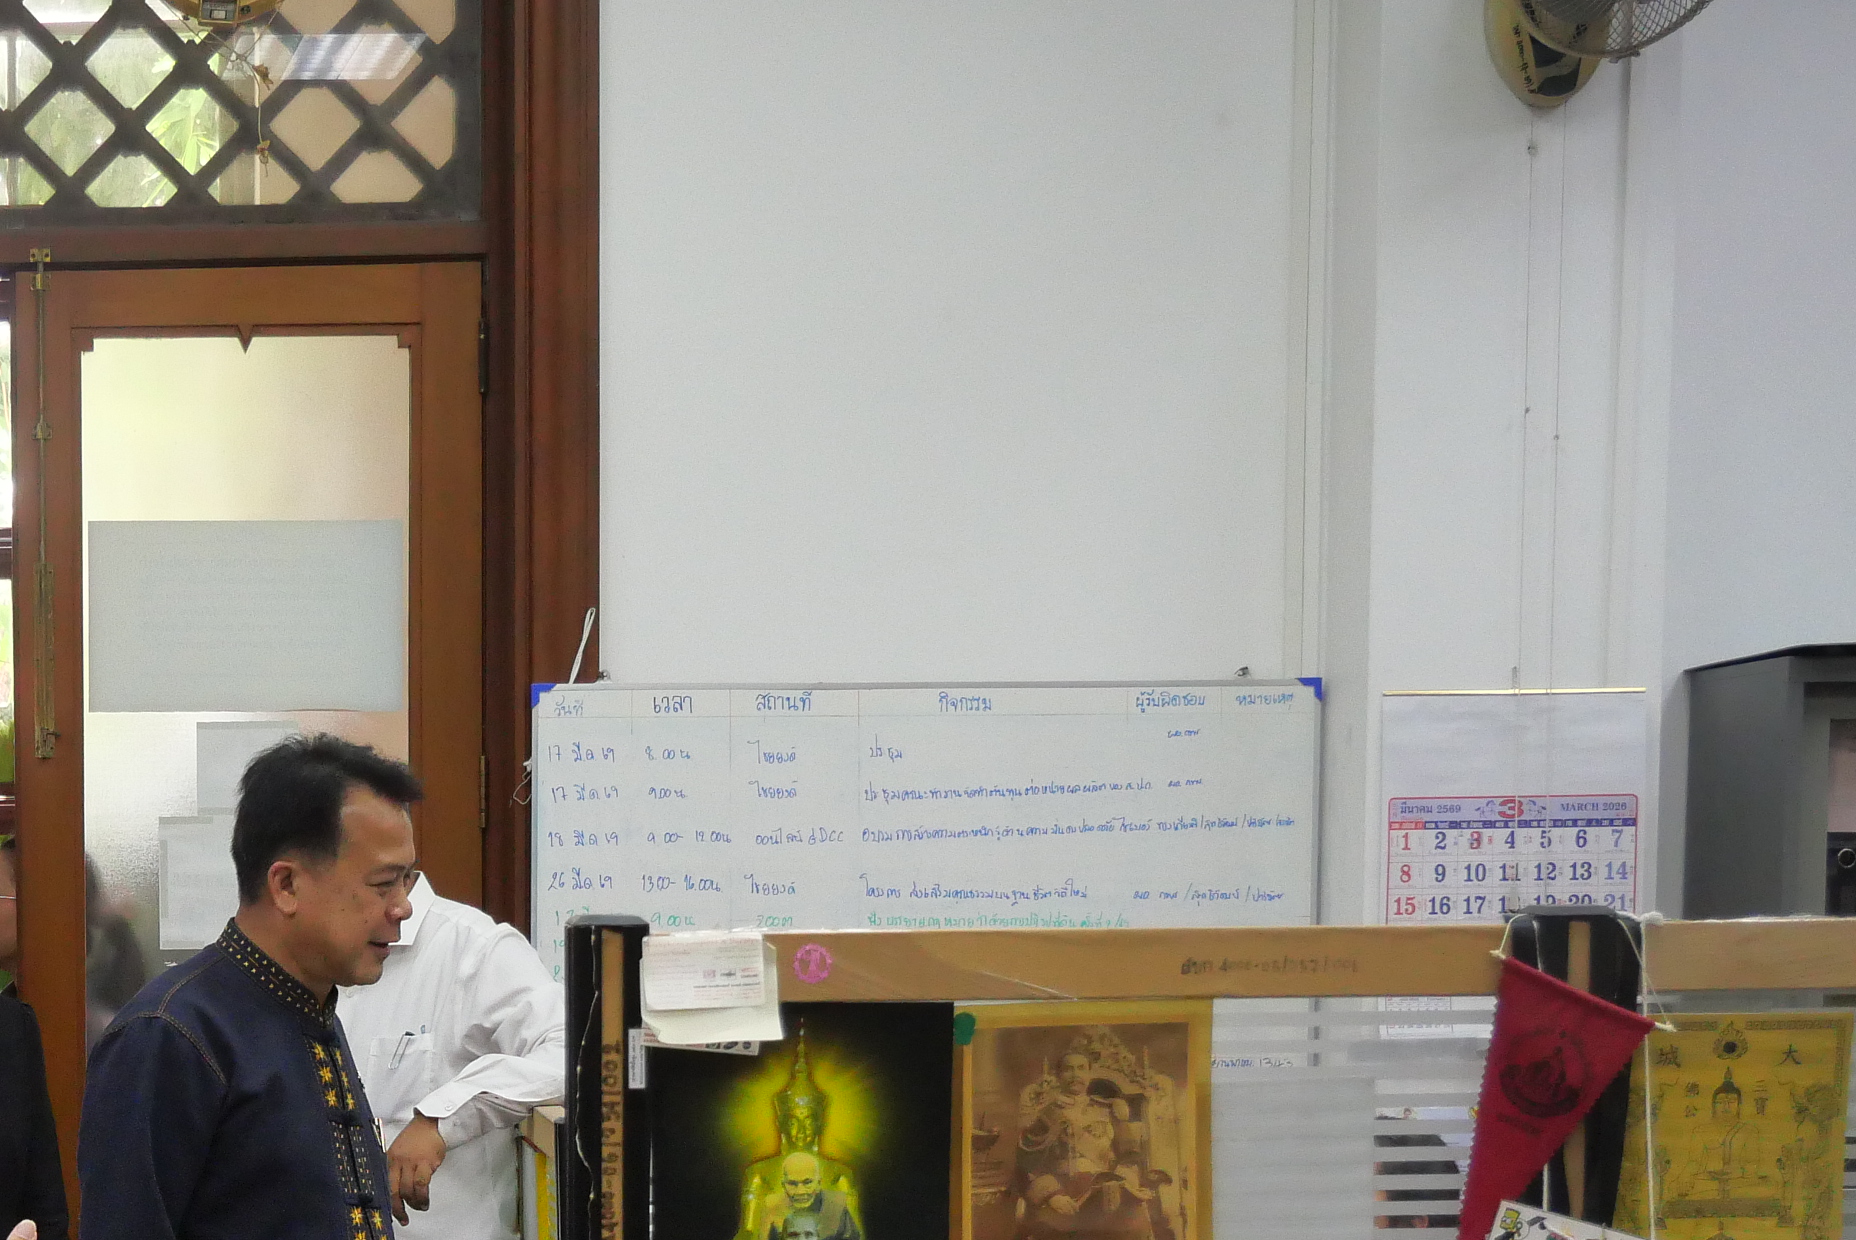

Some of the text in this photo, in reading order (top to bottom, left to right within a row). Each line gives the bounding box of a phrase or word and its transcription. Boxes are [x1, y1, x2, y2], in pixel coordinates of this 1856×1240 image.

[653, 695, 693, 714] เวลา
[938, 691, 992, 713] กิจกรรม
[1136, 690, 1205, 715] ผู้รับผิดชอบ
[1235, 693, 1294, 710] หมายเหตุ
[548, 745, 562, 762] 17
[552, 786, 567, 802] 17
[1436, 803, 1461, 814] 2569
[1497, 798, 1524, 819] 3
[1560, 802, 1627, 812] MARCH 2026
[548, 831, 564, 847] 18
[1402, 829, 1624, 850] 1 2 3 4 5 6 7
[548, 871, 565, 891] 26
[1400, 864, 1411, 883] 8
[1434, 864, 1446, 883] 9
[1463, 863, 1487, 882] 10
[1533, 862, 1557, 881] 12
[1569, 862, 1593, 881] 13
[1604, 861, 1628, 880] 14
[1394, 896, 1416, 915] 15
[1428, 896, 1451, 915] 16
[1463, 896, 1486, 915] 17
[1775, 1043, 1802, 1067] 大
